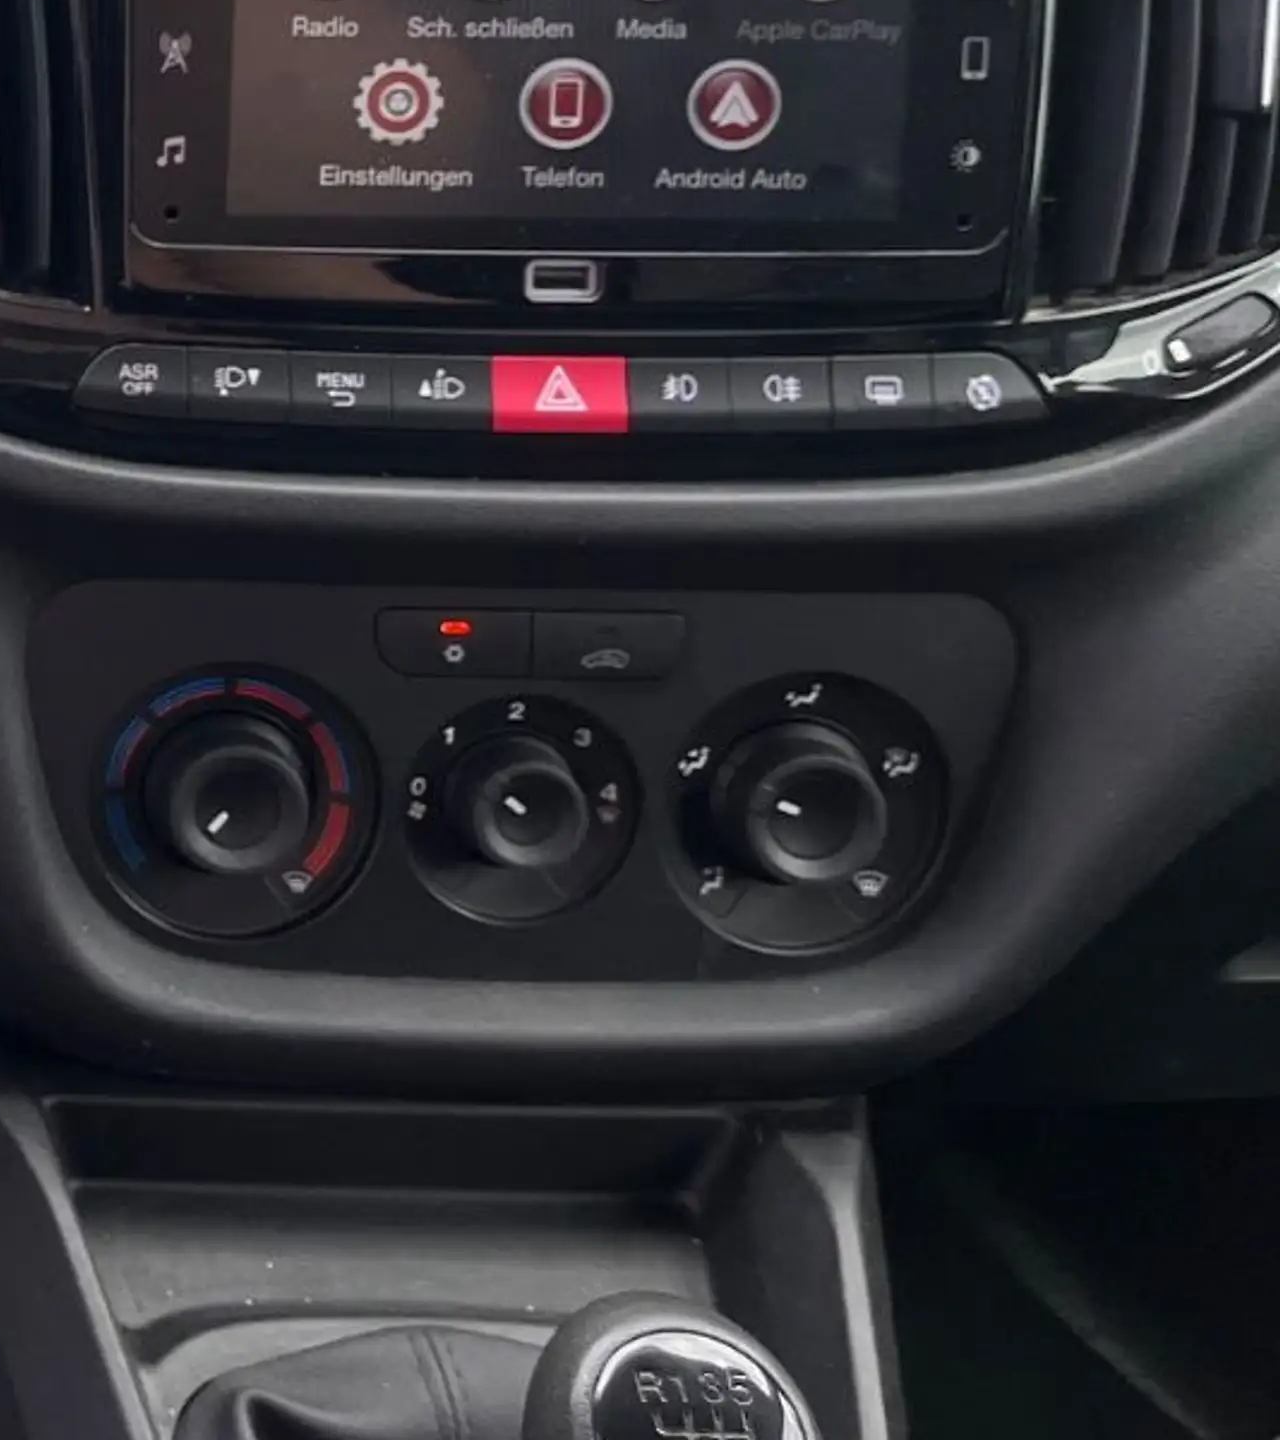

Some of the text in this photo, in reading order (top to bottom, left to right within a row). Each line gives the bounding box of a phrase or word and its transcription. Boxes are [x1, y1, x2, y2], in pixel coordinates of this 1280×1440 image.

[292, 16, 358, 37] Radio
[406, 16, 574, 38] Sch. schließen
[616, 18, 687, 39] Media
[737, 20, 901, 45] Apple CarPlay
[319, 164, 473, 191] Einstellungen
[522, 165, 604, 187] Telefon
[654, 168, 807, 190] Android Auto
[119, 363, 158, 380] ASR
[316, 372, 365, 388] MENU
[122, 381, 155, 396] OFF
[507, 701, 526, 720] 2
[443, 726, 456, 745] 1
[573, 727, 592, 748] 3
[409, 776, 427, 797] 0
[600, 782, 618, 802] 4
